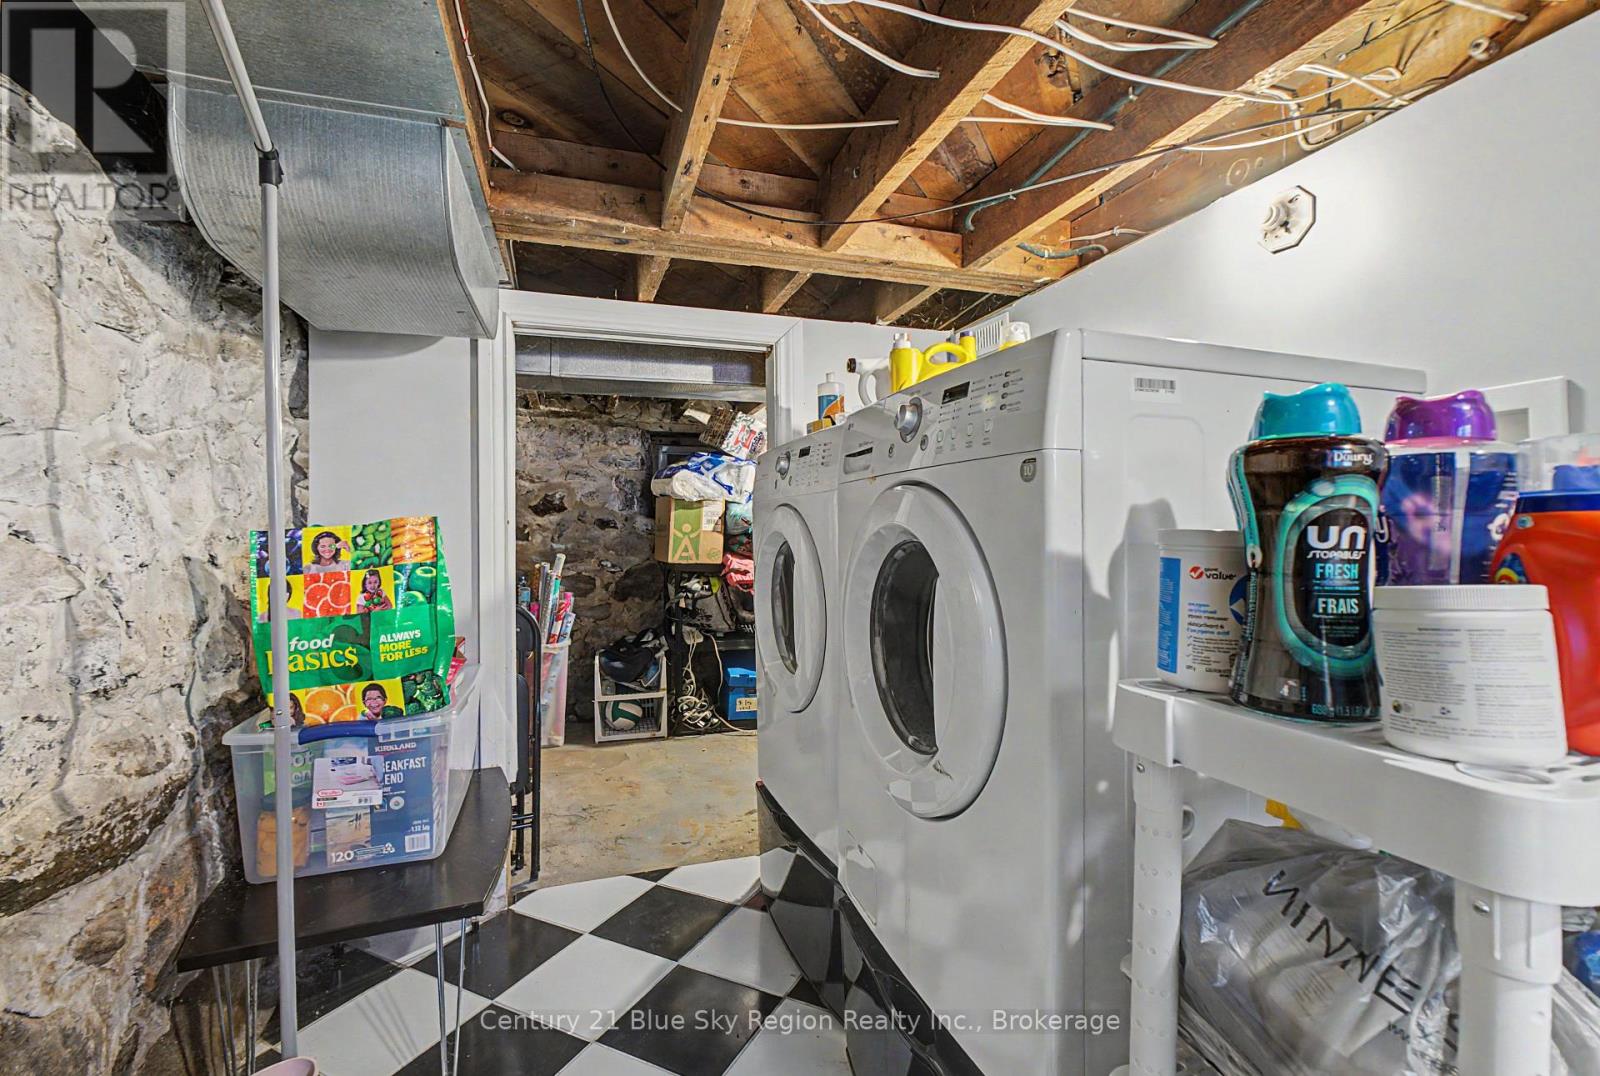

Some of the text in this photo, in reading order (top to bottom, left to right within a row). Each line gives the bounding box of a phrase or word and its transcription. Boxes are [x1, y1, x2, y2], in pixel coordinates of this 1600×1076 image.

[1334, 451, 1374, 465] Downy
[1315, 563, 1359, 579] FRESH
[1318, 598, 1359, 614] FRAIS
[289, 633, 335, 652] food
[379, 630, 421, 643] ALWAYS
[380, 640, 412, 653] MORE
[381, 646, 428, 662] FOR LESS
[375, 742, 417, 753] KIRKLAND
[383, 756, 427, 773] EAKFAST
[331, 850, 355, 864] 120
